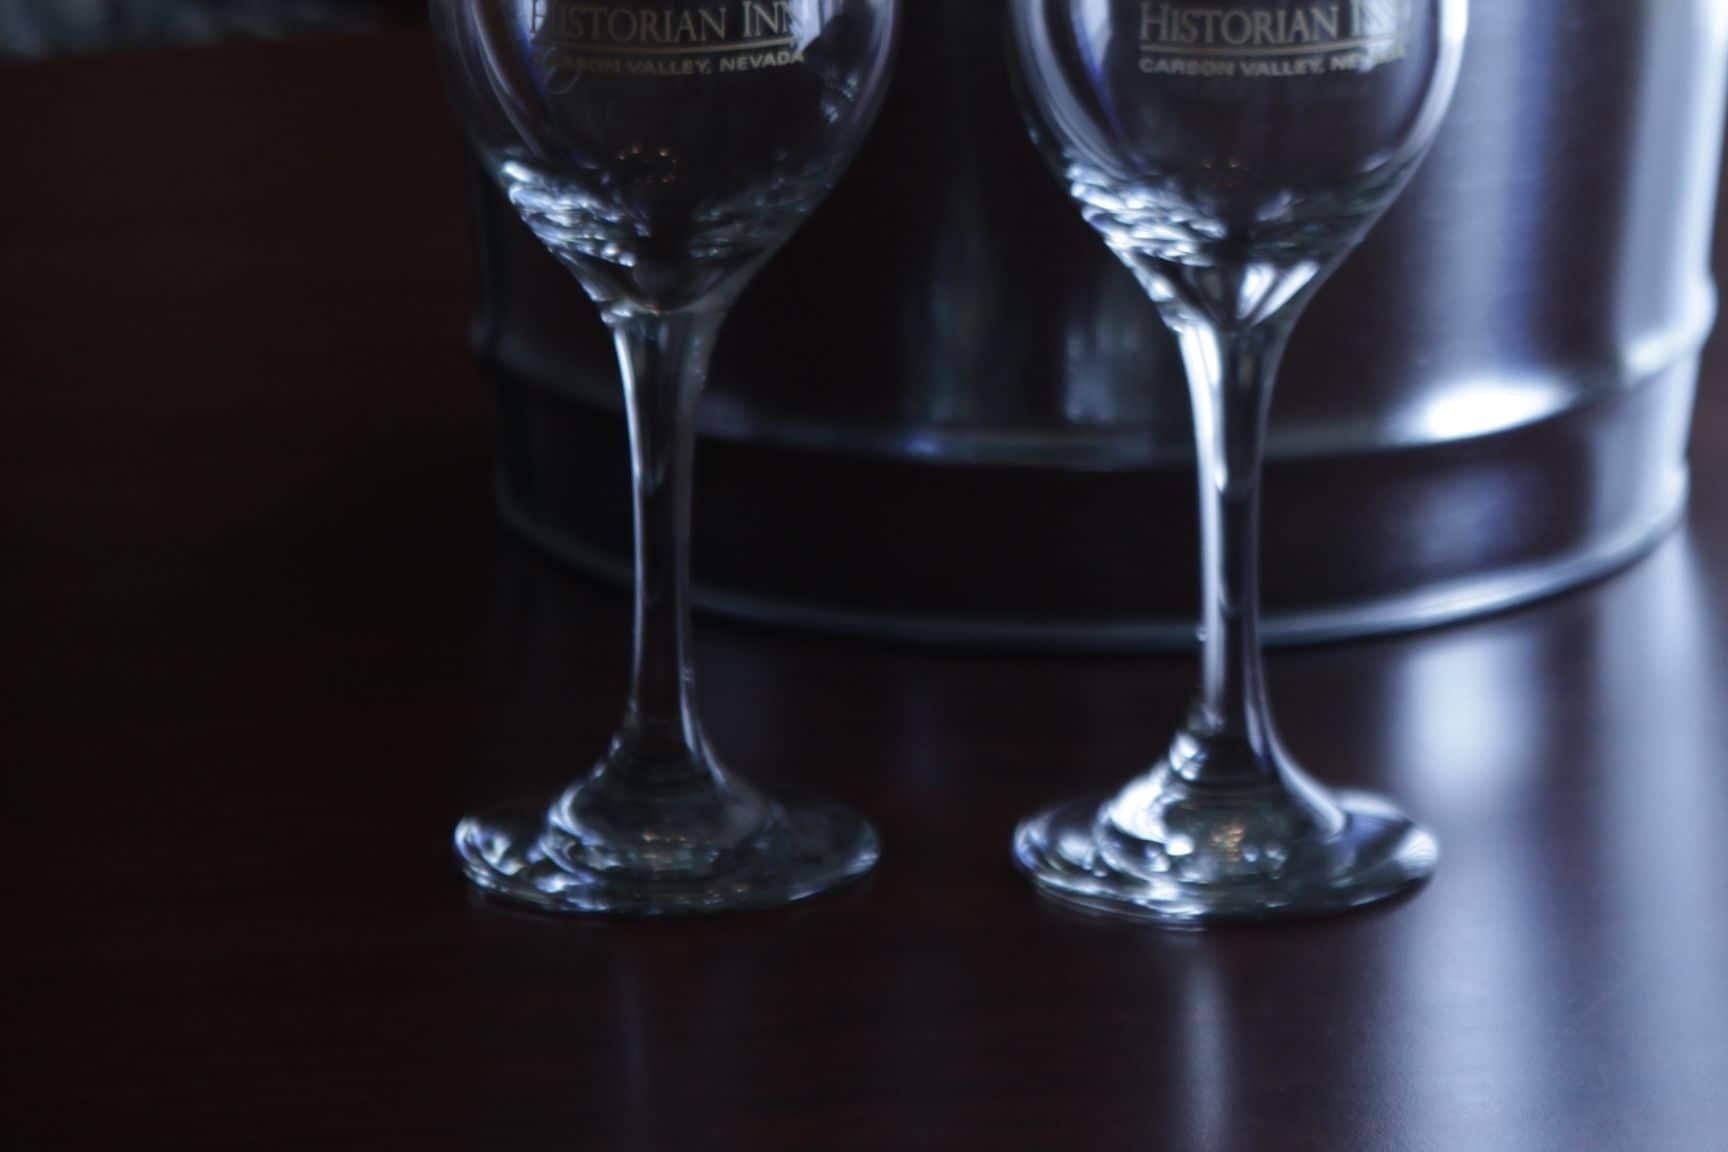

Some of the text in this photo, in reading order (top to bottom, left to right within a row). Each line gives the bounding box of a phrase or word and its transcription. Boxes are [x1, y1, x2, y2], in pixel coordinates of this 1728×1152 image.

[1138, 0, 1340, 46] HISTORIAN
[719, 50, 805, 74] NEVADA
[1138, 56, 1234, 77] CARSON
